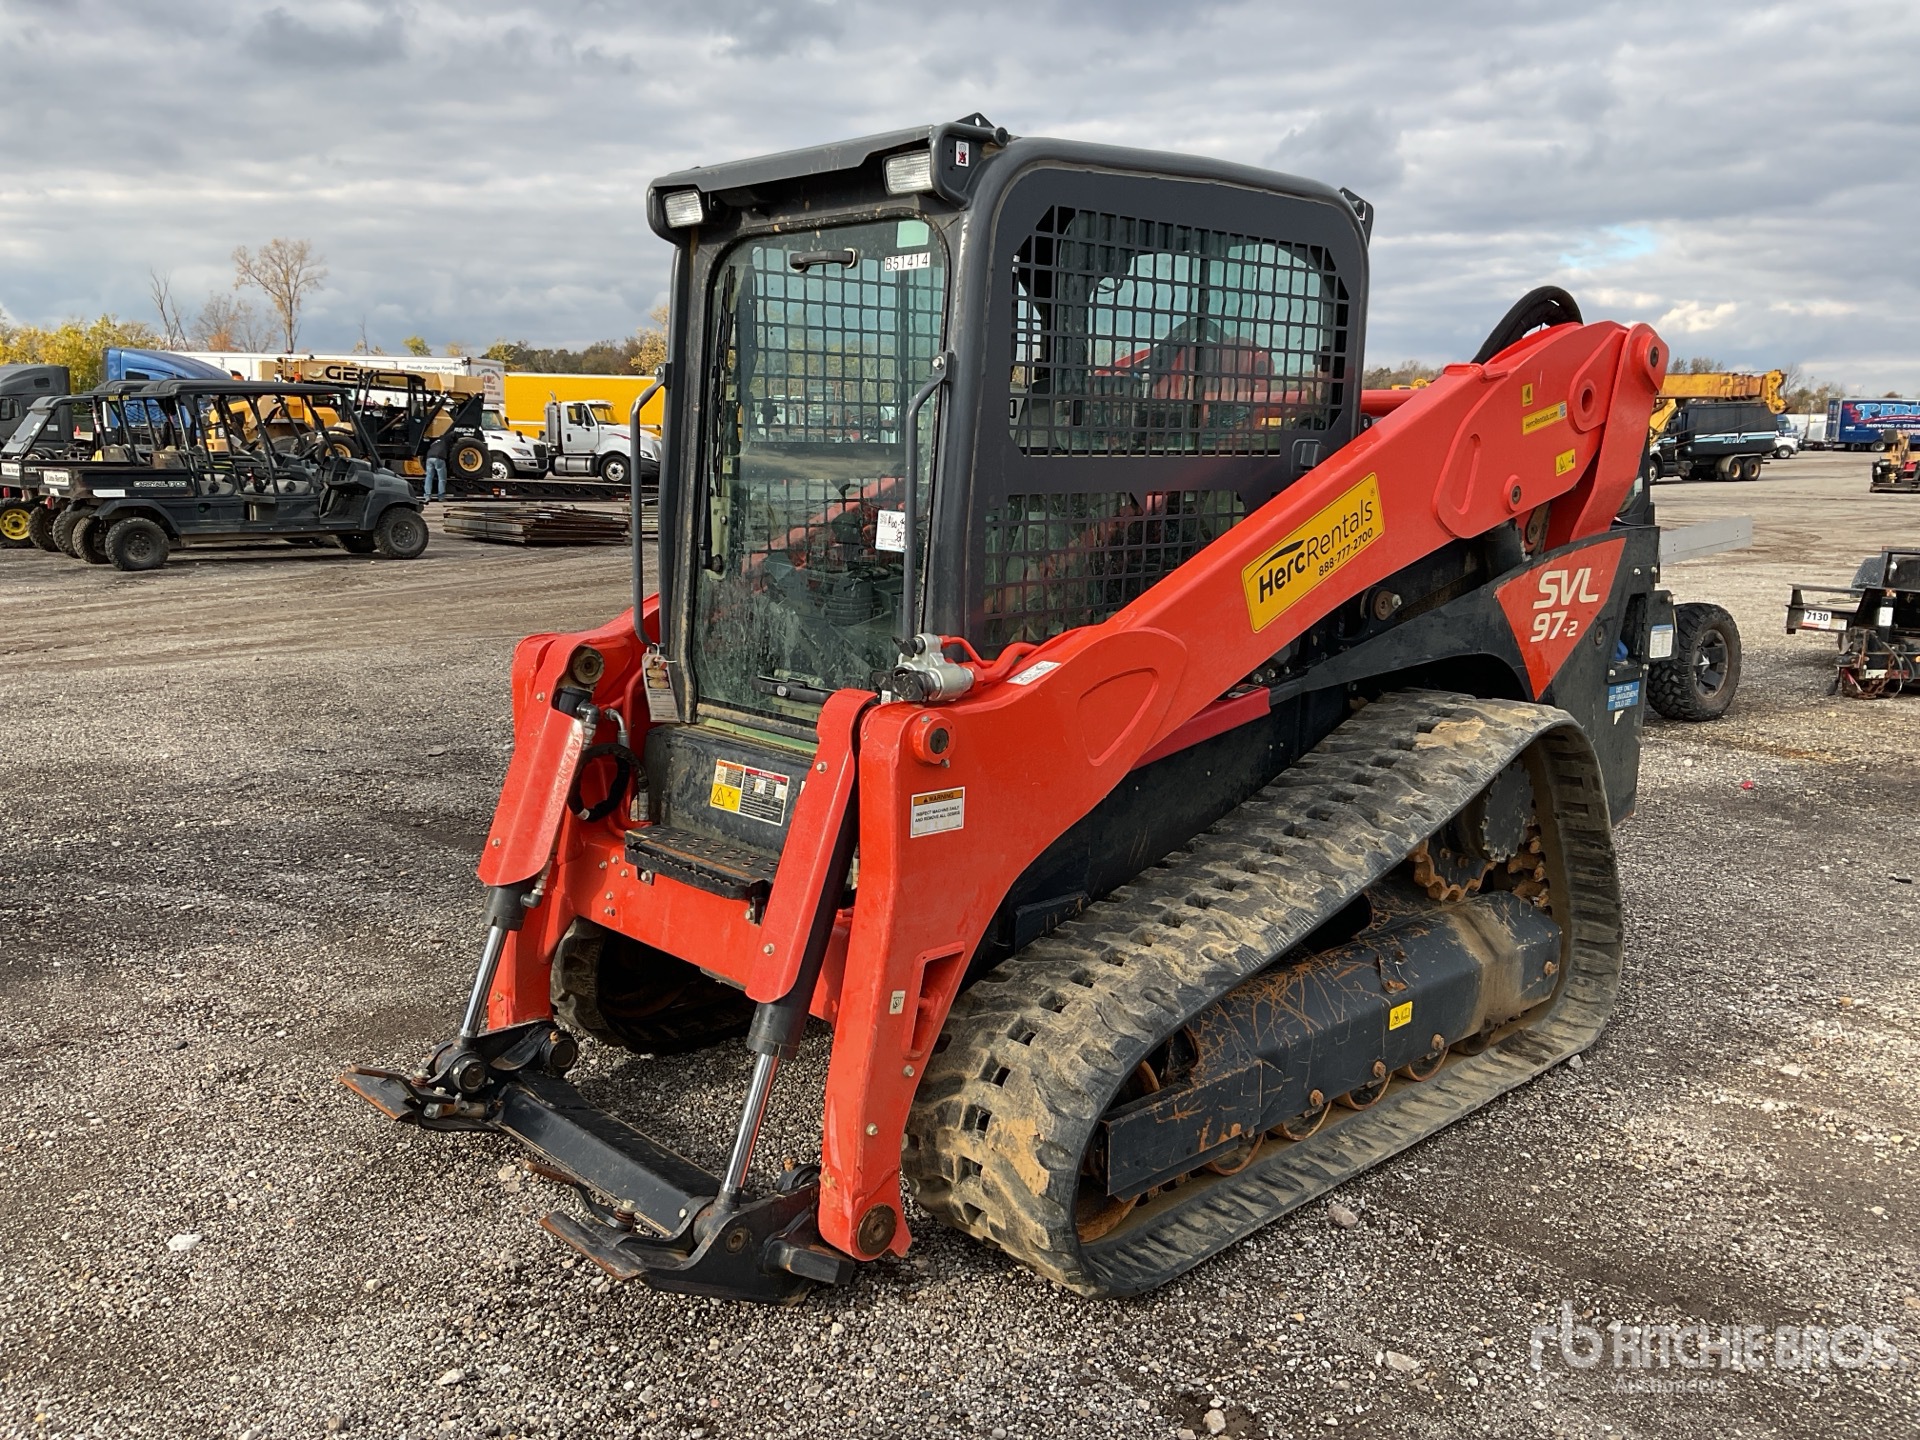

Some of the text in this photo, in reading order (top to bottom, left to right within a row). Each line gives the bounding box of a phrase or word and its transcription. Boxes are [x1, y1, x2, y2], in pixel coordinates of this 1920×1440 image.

[885, 254, 929, 270] B51414
[1258, 499, 1373, 604] HercRentals
[1318, 527, 1373, 577] 888-777-2700
[1532, 568, 1599, 609] SVL
[1529, 611, 1579, 643] 97-2
[1806, 612, 1829, 622] 7130
[929, 792, 954, 802] WARNING
